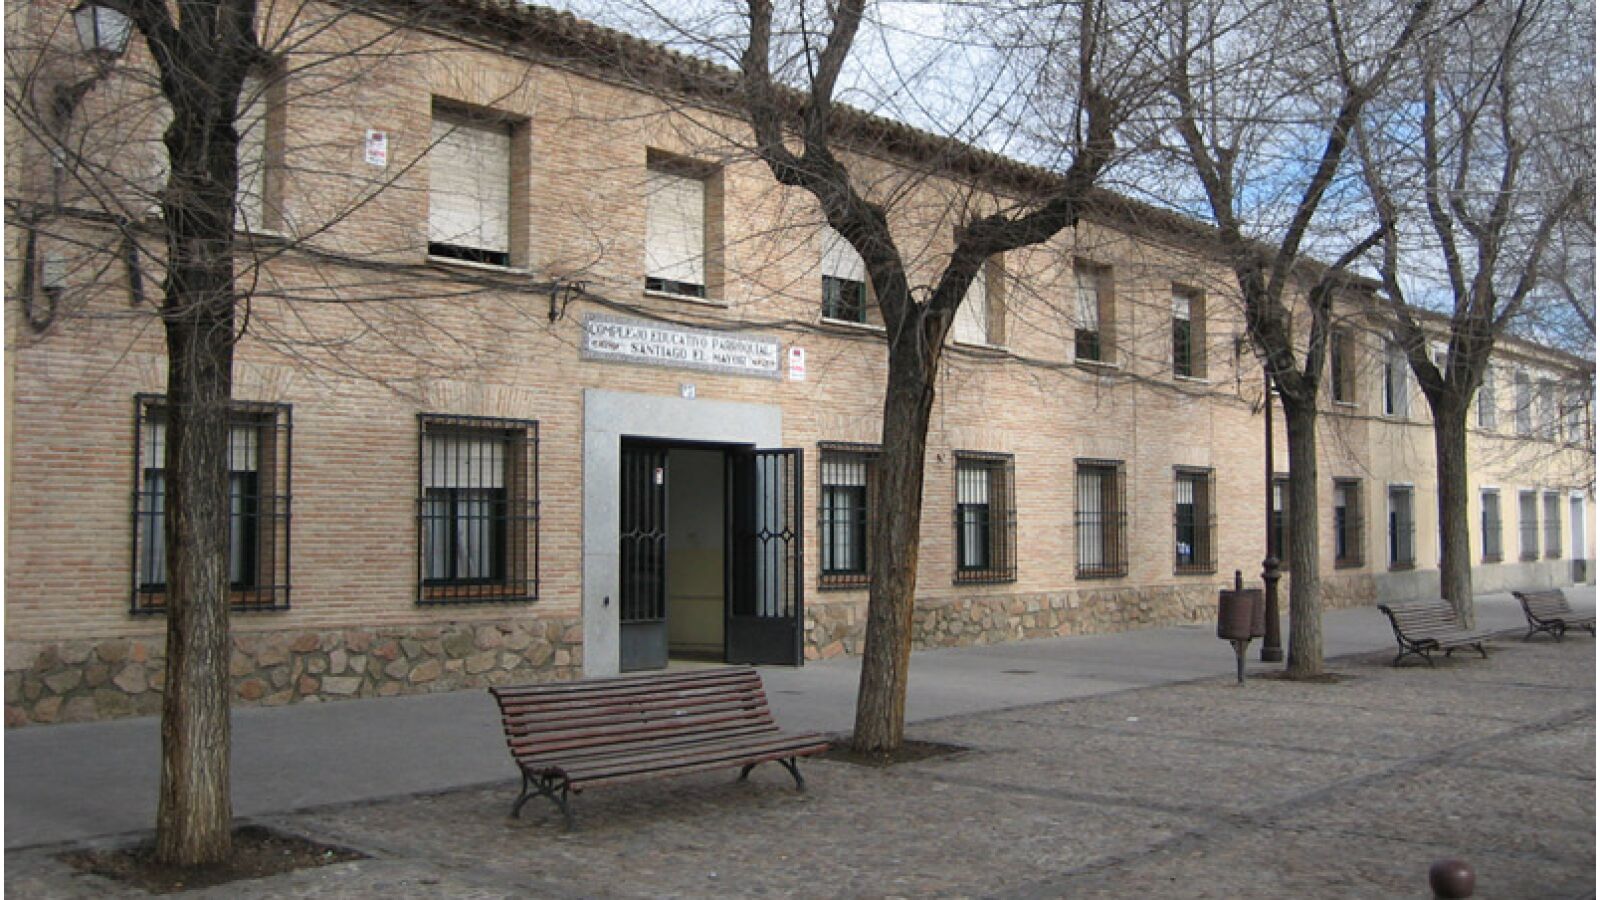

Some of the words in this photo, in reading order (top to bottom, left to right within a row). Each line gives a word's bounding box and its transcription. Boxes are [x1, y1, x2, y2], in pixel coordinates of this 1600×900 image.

[651, 329, 707, 349] EDUCATIVO
[630, 342, 688, 360] SANTIAGO
[693, 349, 704, 361] EL
